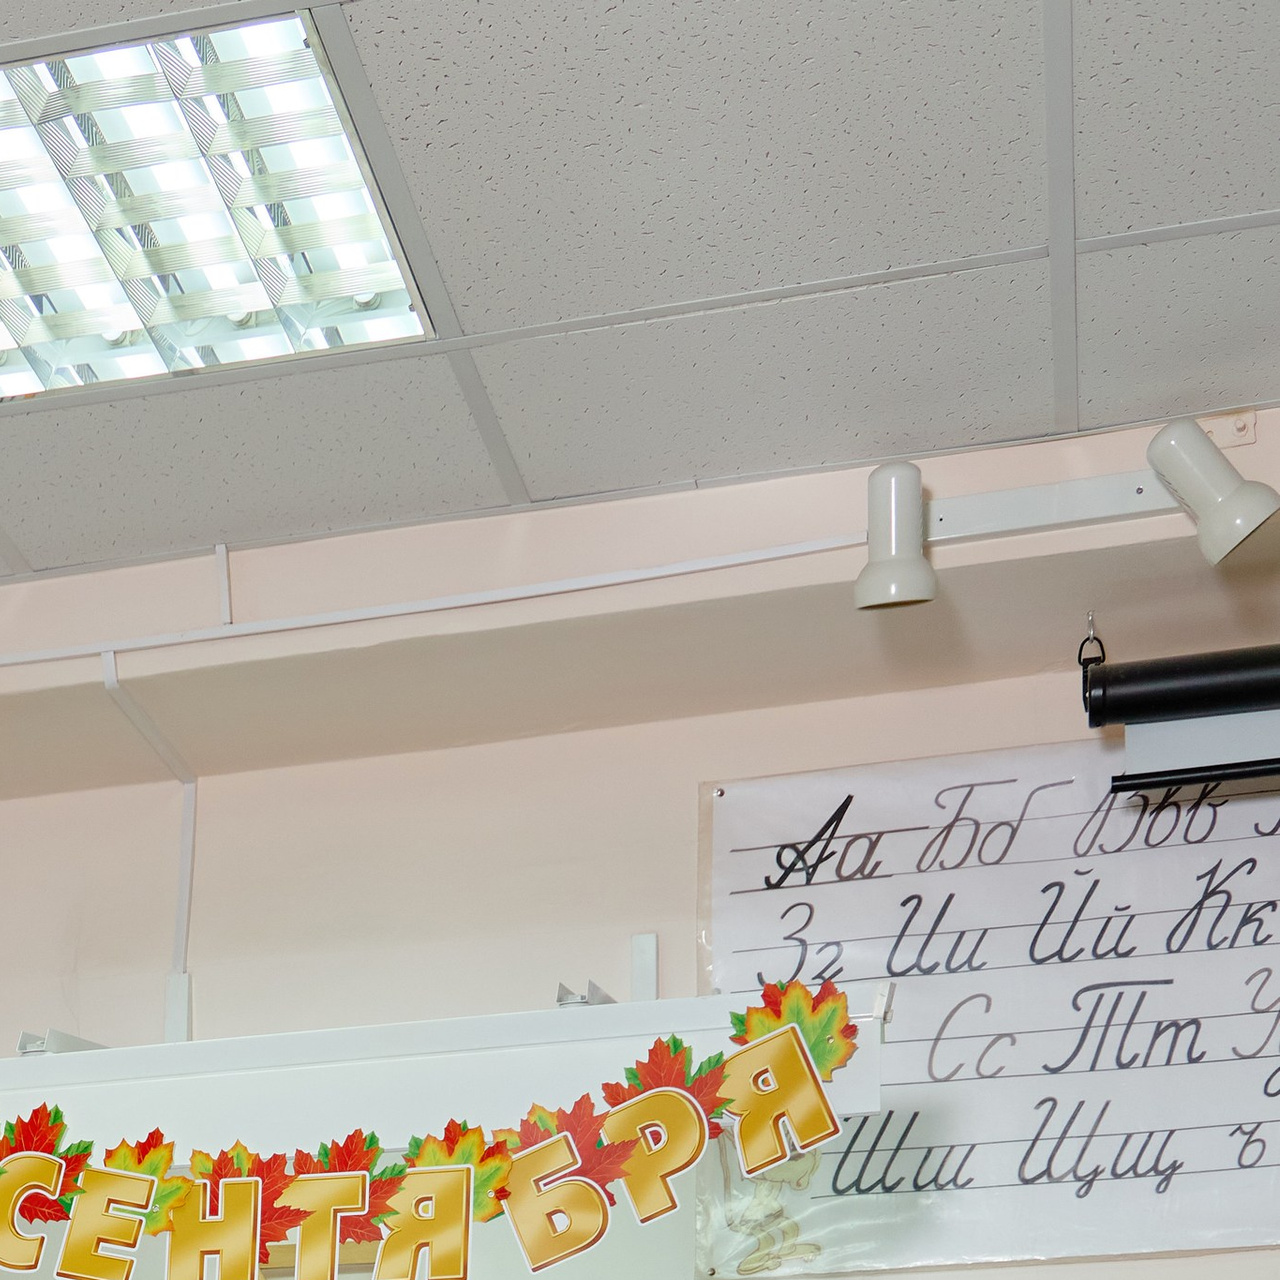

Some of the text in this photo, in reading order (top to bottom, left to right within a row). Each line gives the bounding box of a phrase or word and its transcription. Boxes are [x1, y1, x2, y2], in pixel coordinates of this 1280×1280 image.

[764, 794, 884, 890] Аа
[916, 776, 1076, 873] Бб
[885, 892, 990, 977] Ии
[1027, 869, 1138, 966] Йй
[1165, 857, 1280, 953] Кк
[927, 992, 1018, 1082] Сс
